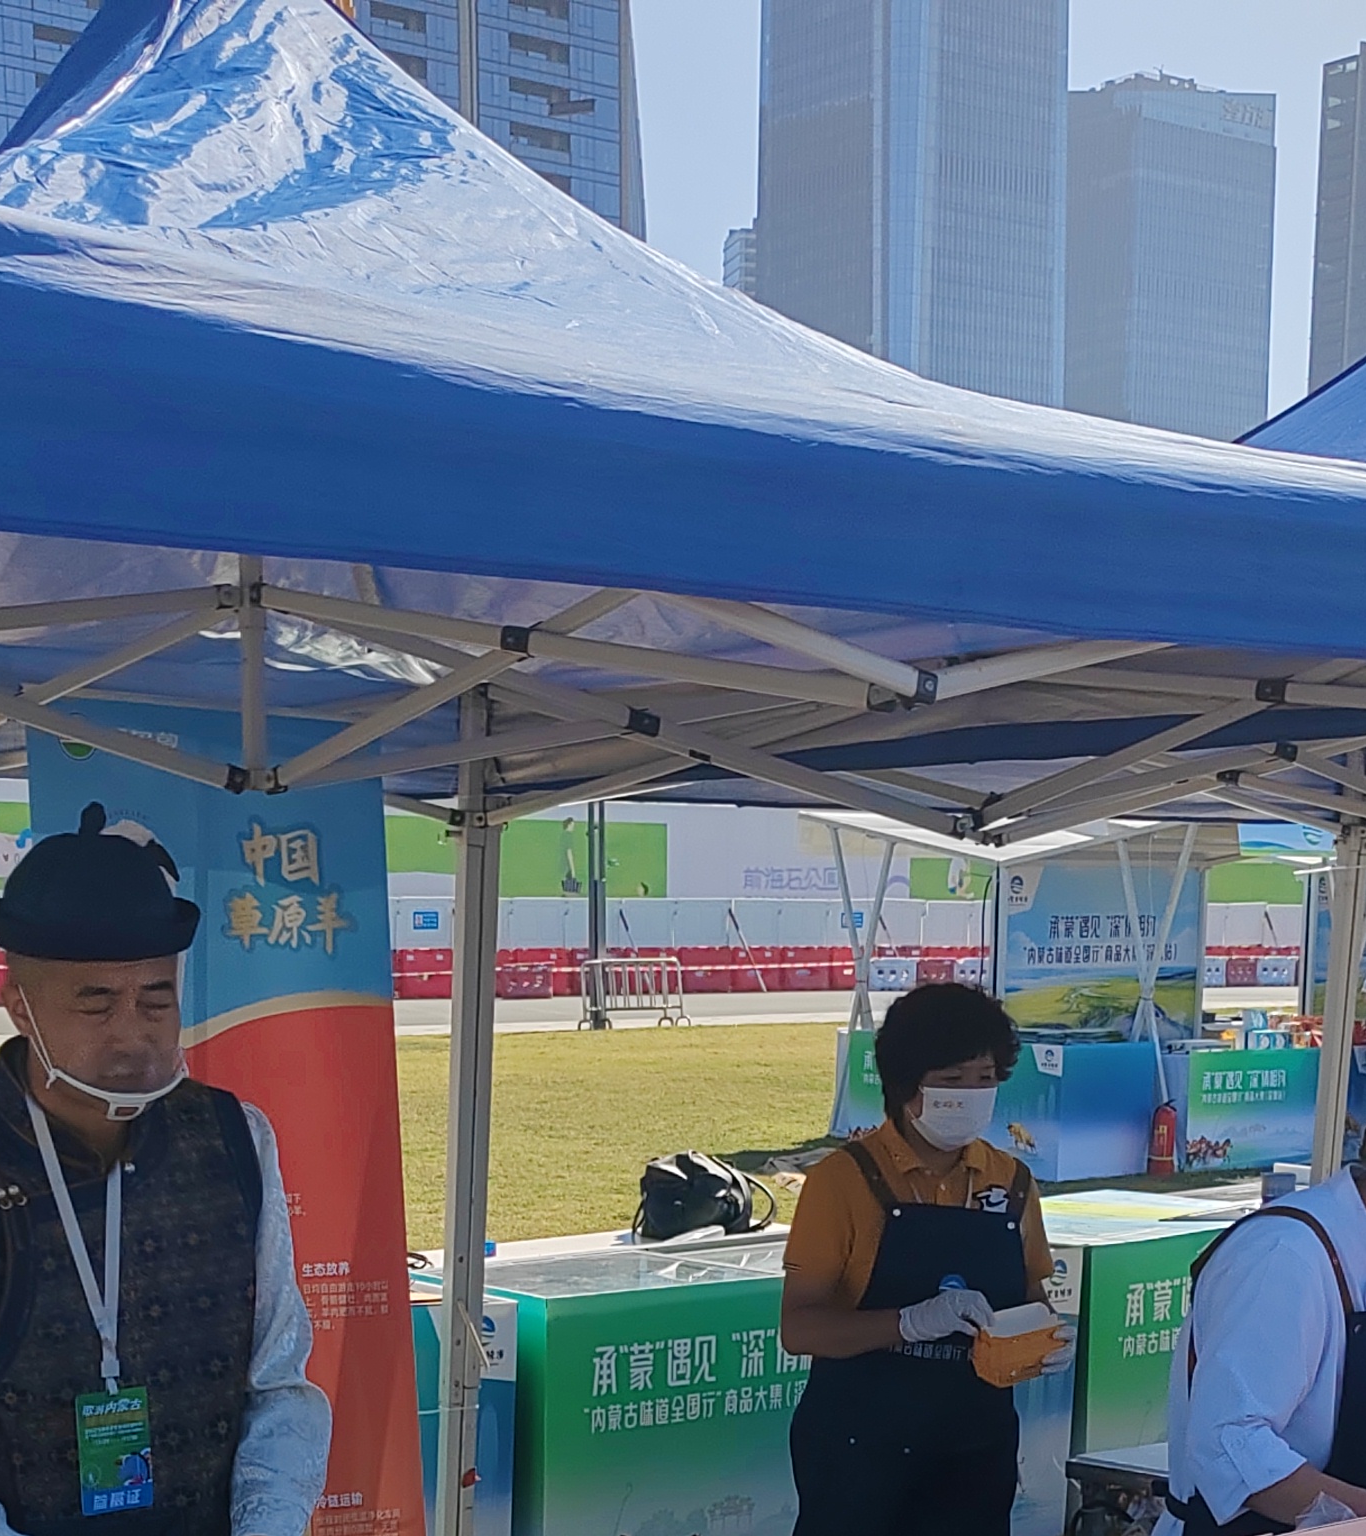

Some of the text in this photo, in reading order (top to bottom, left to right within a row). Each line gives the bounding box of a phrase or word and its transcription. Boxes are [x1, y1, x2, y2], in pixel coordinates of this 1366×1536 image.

[242, 822, 321, 887] 中国
[226, 891, 349, 955] 草原羊
[301, 1261, 351, 1278] 生态放养
[316, 1491, 363, 1509] 冷链运输
